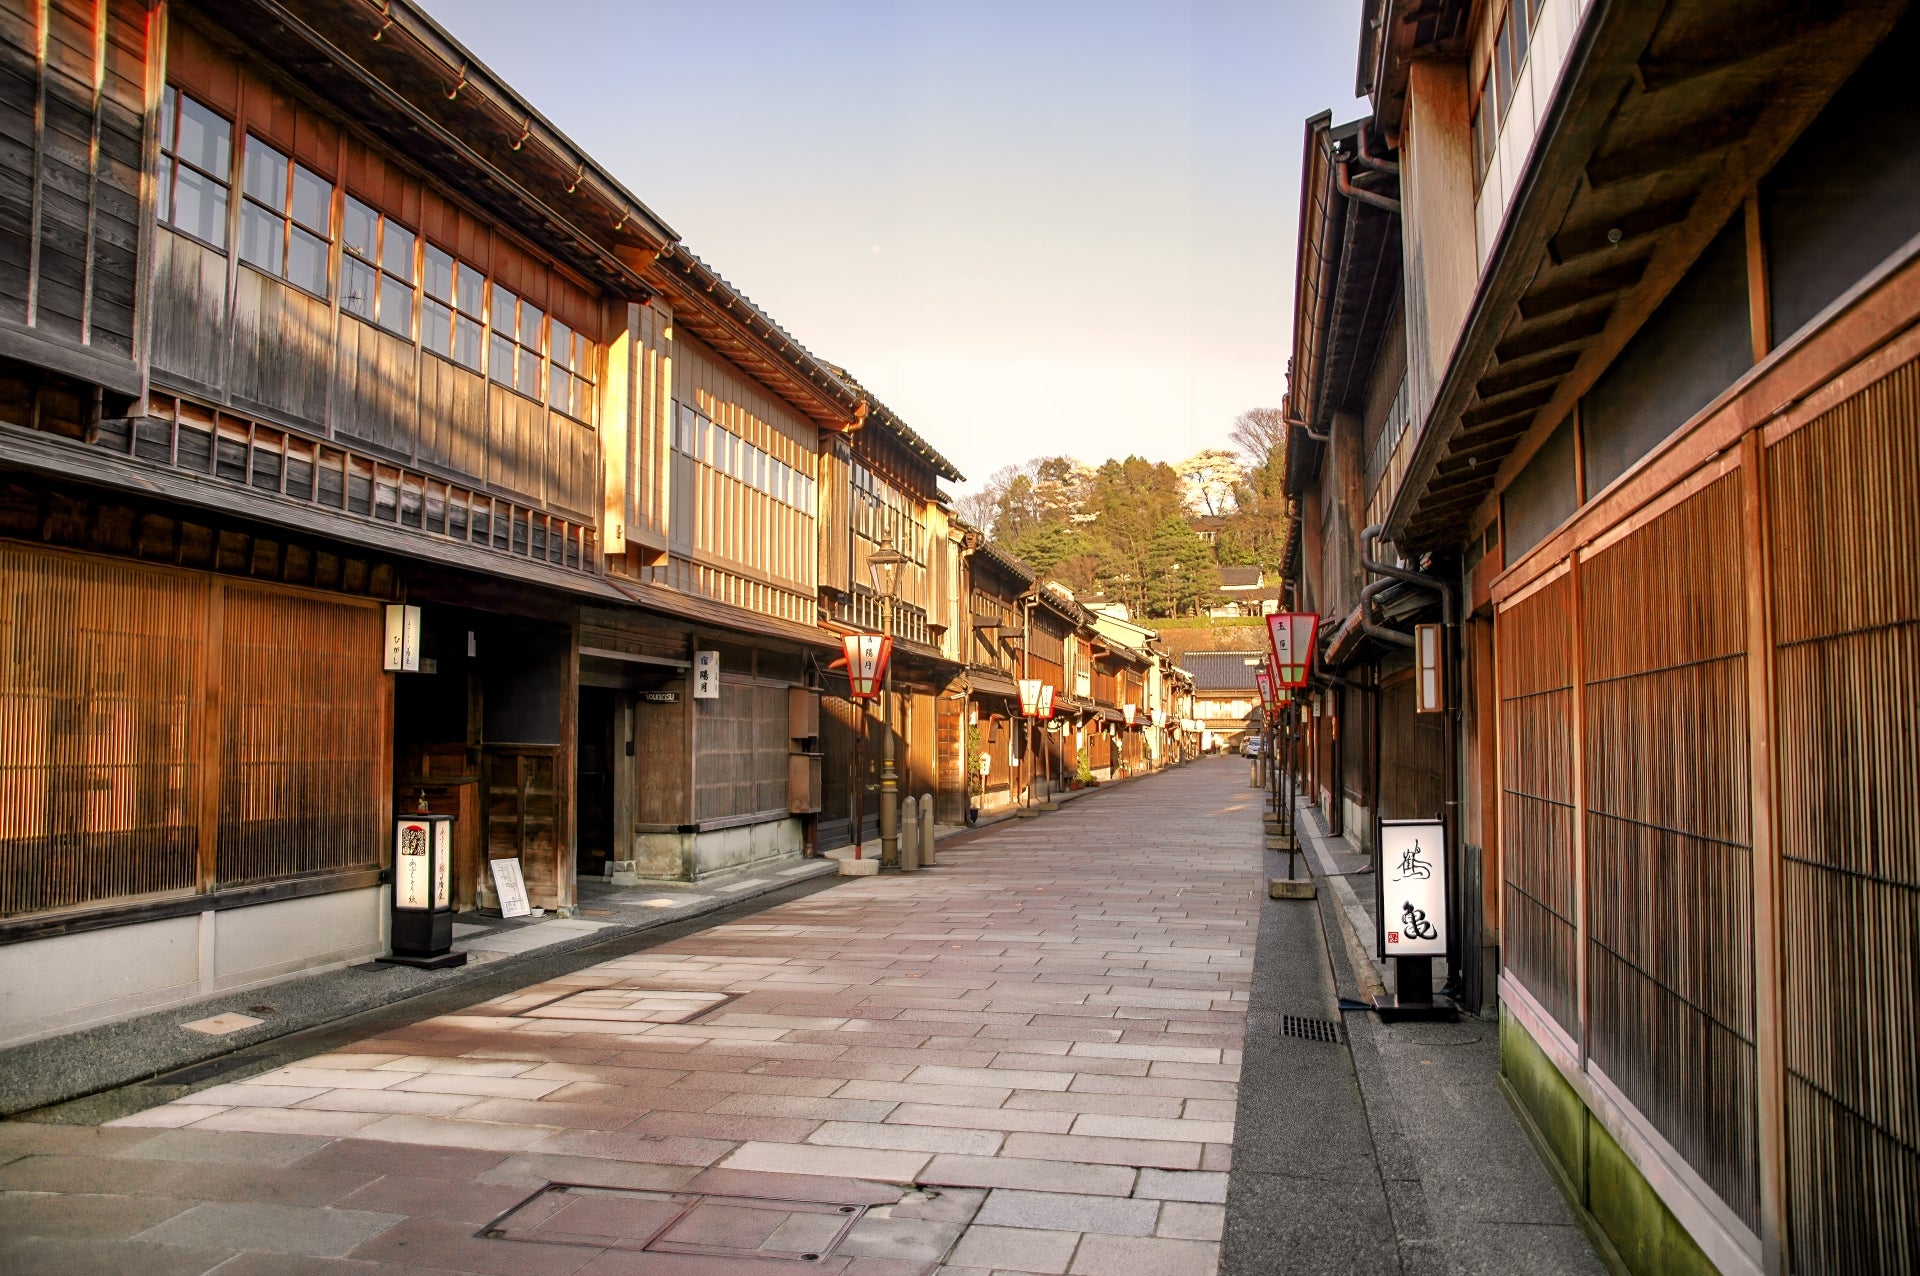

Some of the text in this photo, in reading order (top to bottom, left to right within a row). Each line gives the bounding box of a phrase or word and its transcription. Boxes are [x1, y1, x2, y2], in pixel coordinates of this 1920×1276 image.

[393, 635, 401, 665] ひがし
[1392, 839, 1438, 940] 鶴亀
